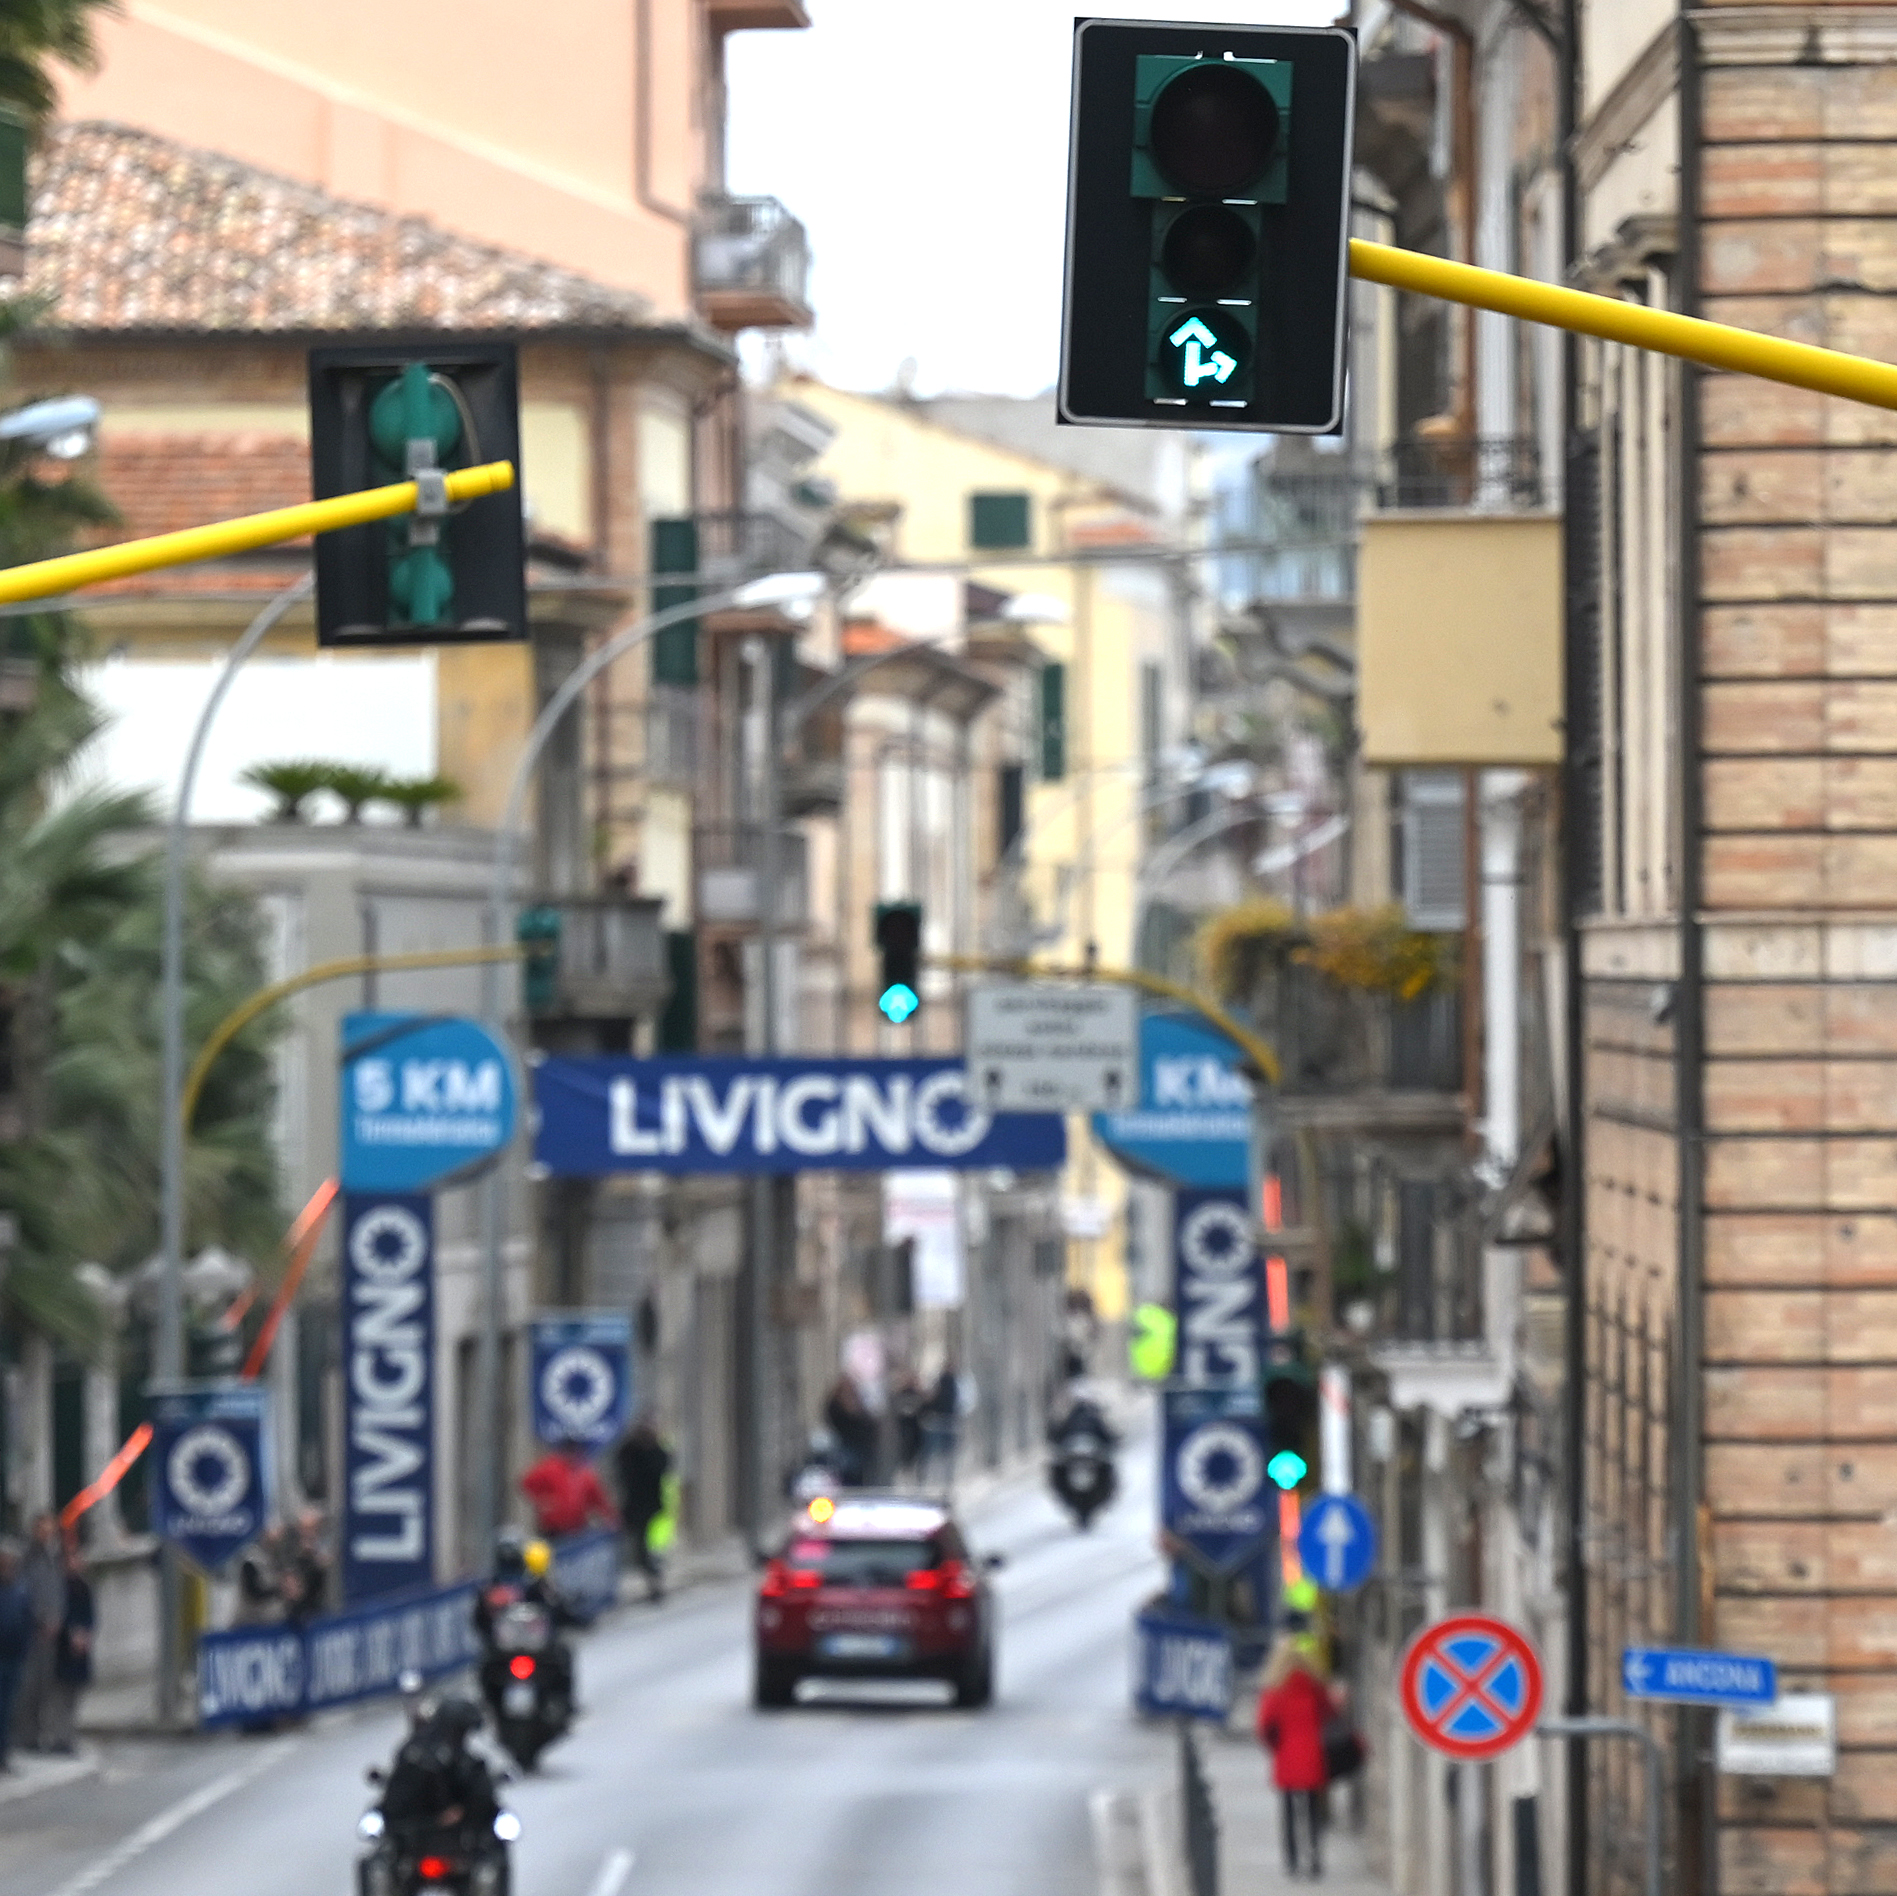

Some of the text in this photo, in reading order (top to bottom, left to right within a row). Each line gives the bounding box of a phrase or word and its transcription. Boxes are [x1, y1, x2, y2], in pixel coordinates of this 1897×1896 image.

[356, 1056, 502, 1113] 5 KM
[610, 1070, 991, 1156] LIVIGNO
[350, 1204, 426, 1561] LIVIGNO
